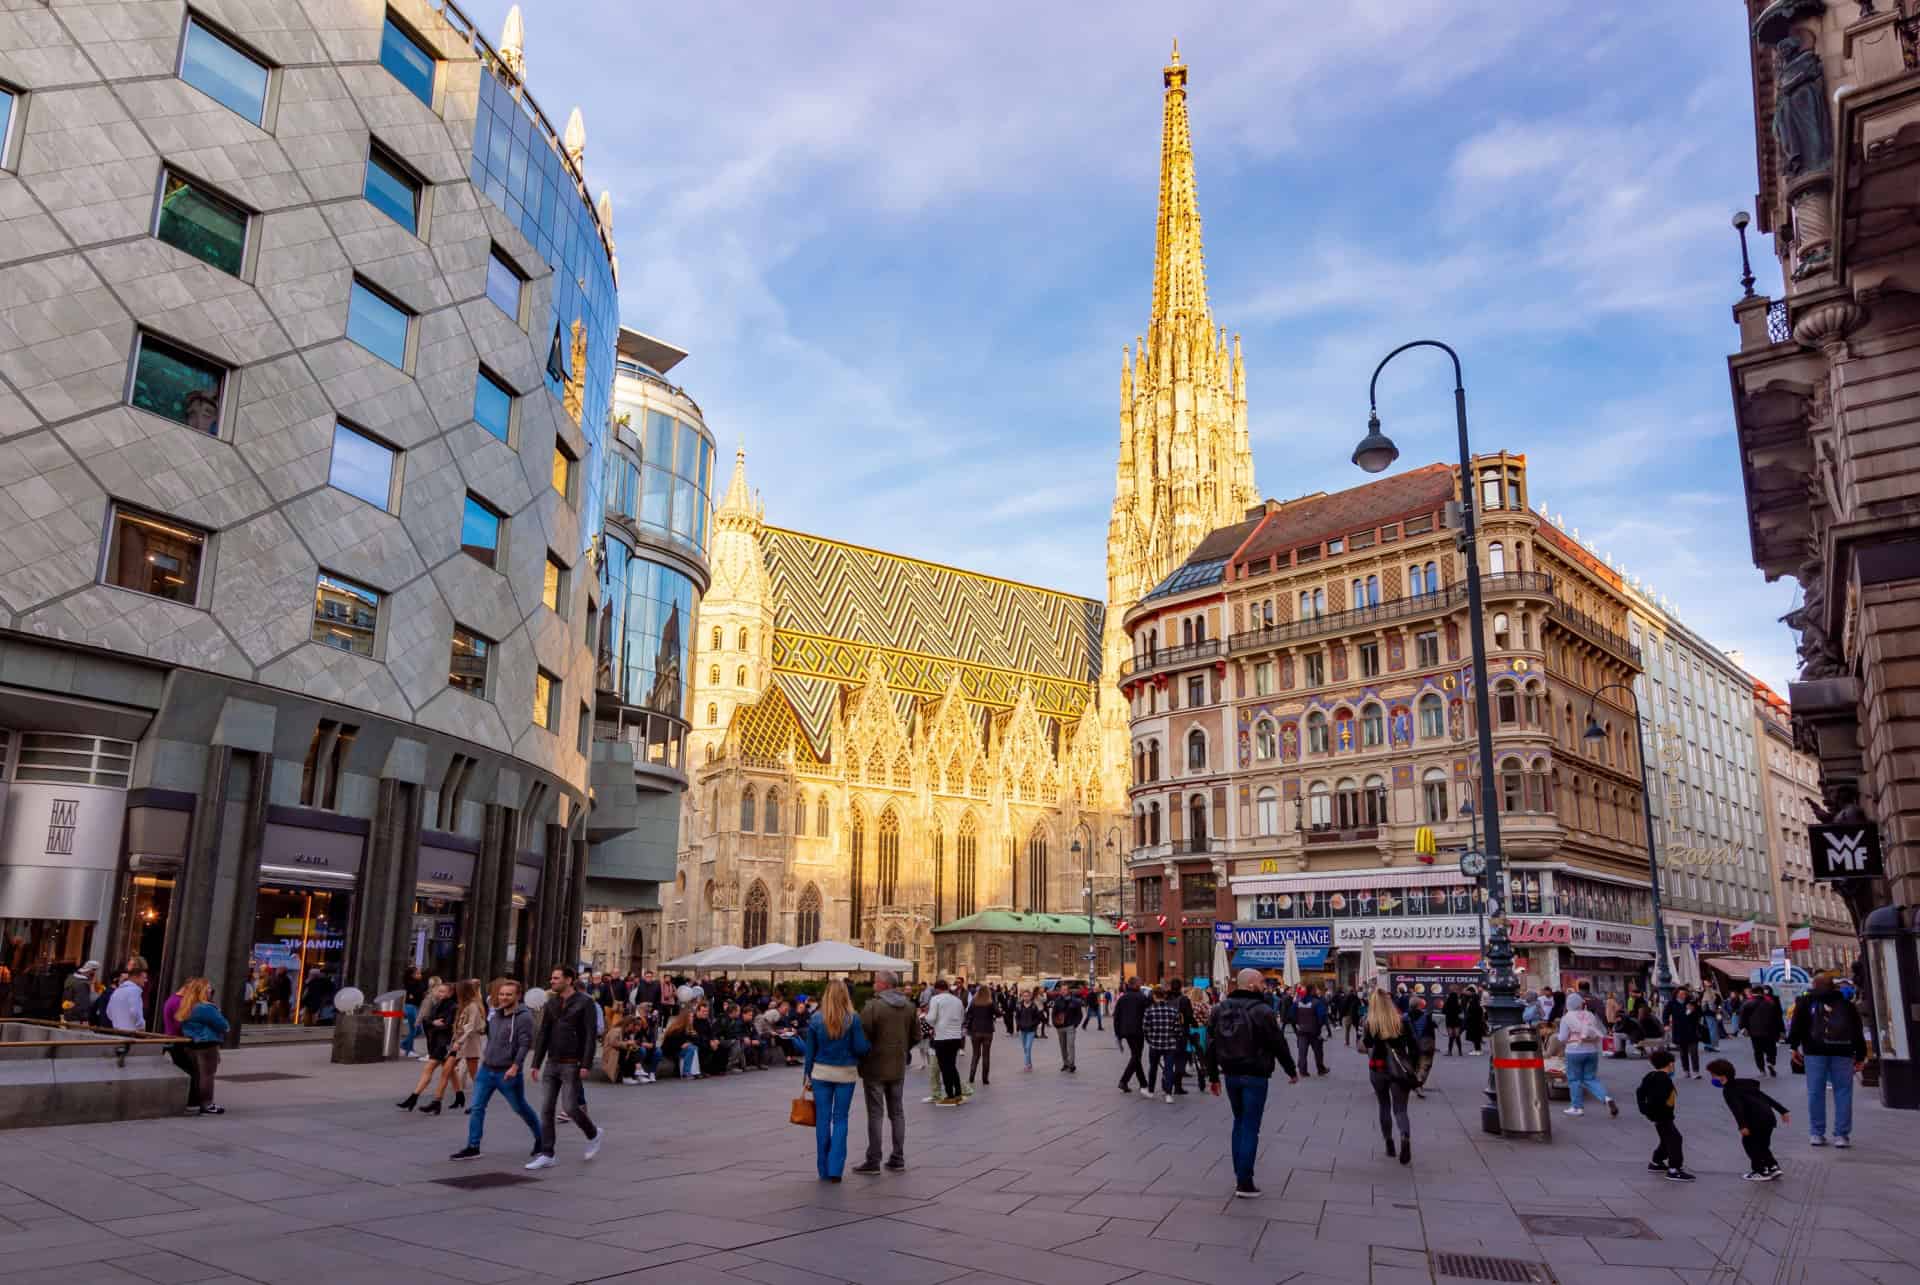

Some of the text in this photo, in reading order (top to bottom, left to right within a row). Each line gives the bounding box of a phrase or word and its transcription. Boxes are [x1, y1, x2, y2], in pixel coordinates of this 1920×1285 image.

[51, 800, 79, 825] HAAS
[46, 827, 75, 852] HAUS
[1235, 930, 1272, 945] MONEY
[1273, 929, 1330, 945] EXCHANGE
[1382, 925, 1478, 939] KONDITORE
